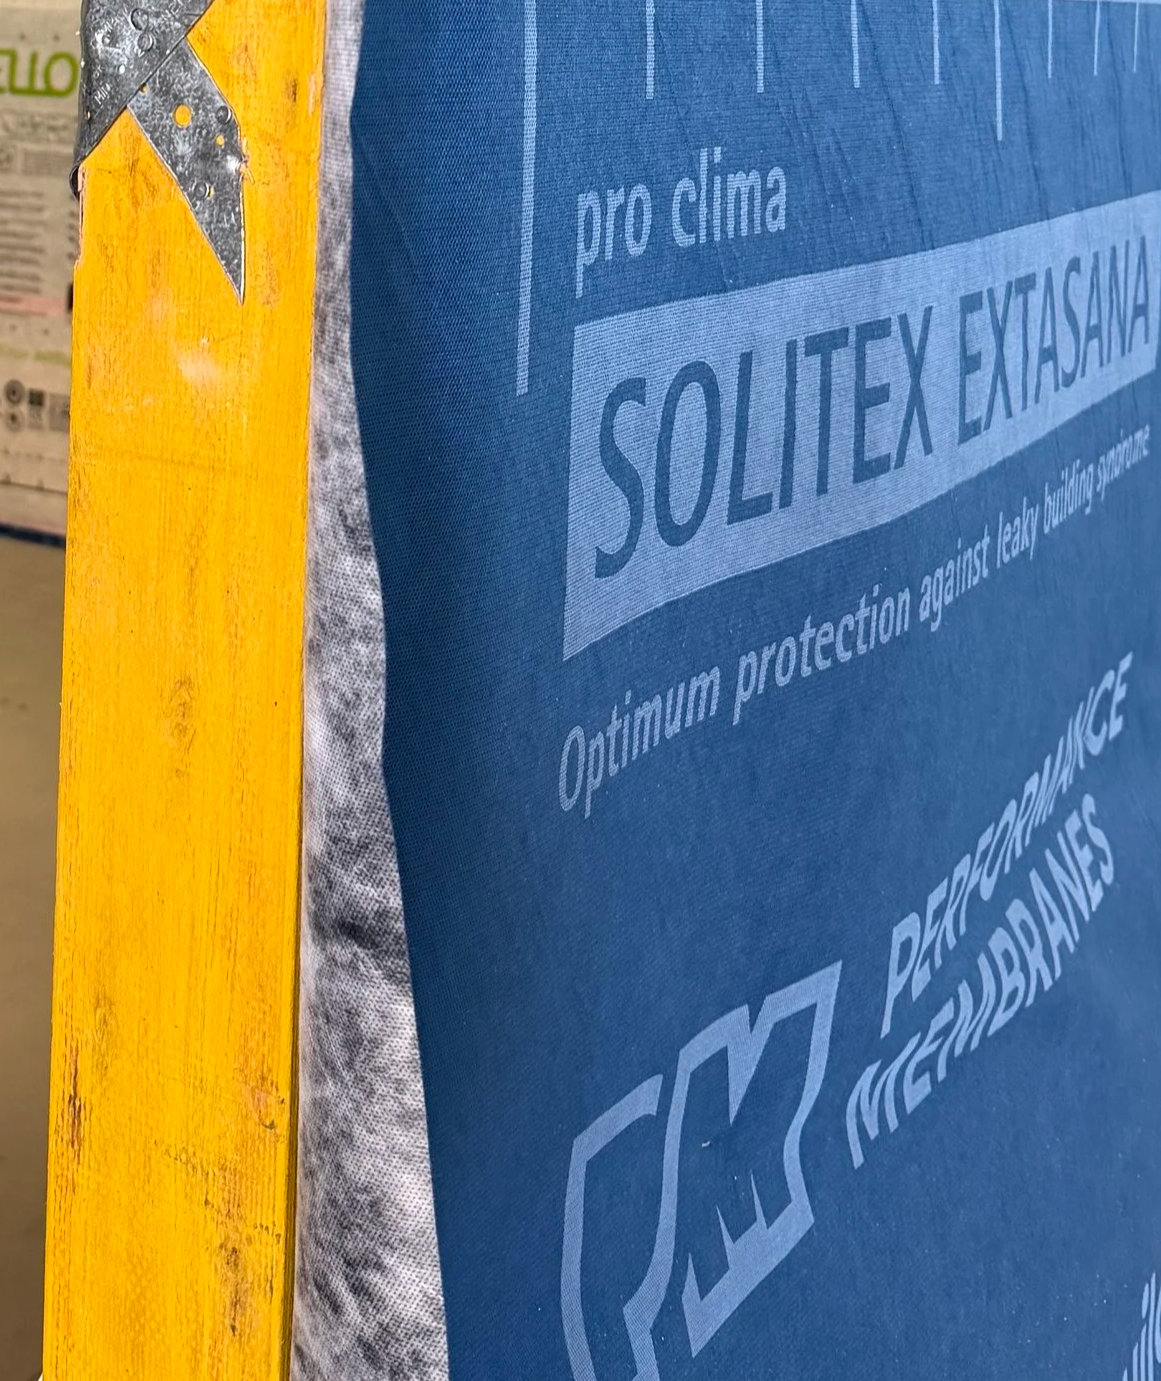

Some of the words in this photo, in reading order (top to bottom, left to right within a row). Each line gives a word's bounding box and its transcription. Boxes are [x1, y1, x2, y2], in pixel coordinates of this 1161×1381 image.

[574, 180, 654, 298] pro
[670, 148, 789, 248] clima
[595, 305, 935, 580] SOLITEX
[956, 233, 1152, 447] EXTASANA
[558, 665, 721, 817] Optimum
[731, 587, 911, 726] protection
[918, 538, 991, 624] against
[995, 503, 1039, 568] leaky
[1042, 459, 1095, 536] building
[845, 792, 1116, 1171] MEMBRANES
[880, 651, 1134, 1039] PERFORMANCE
